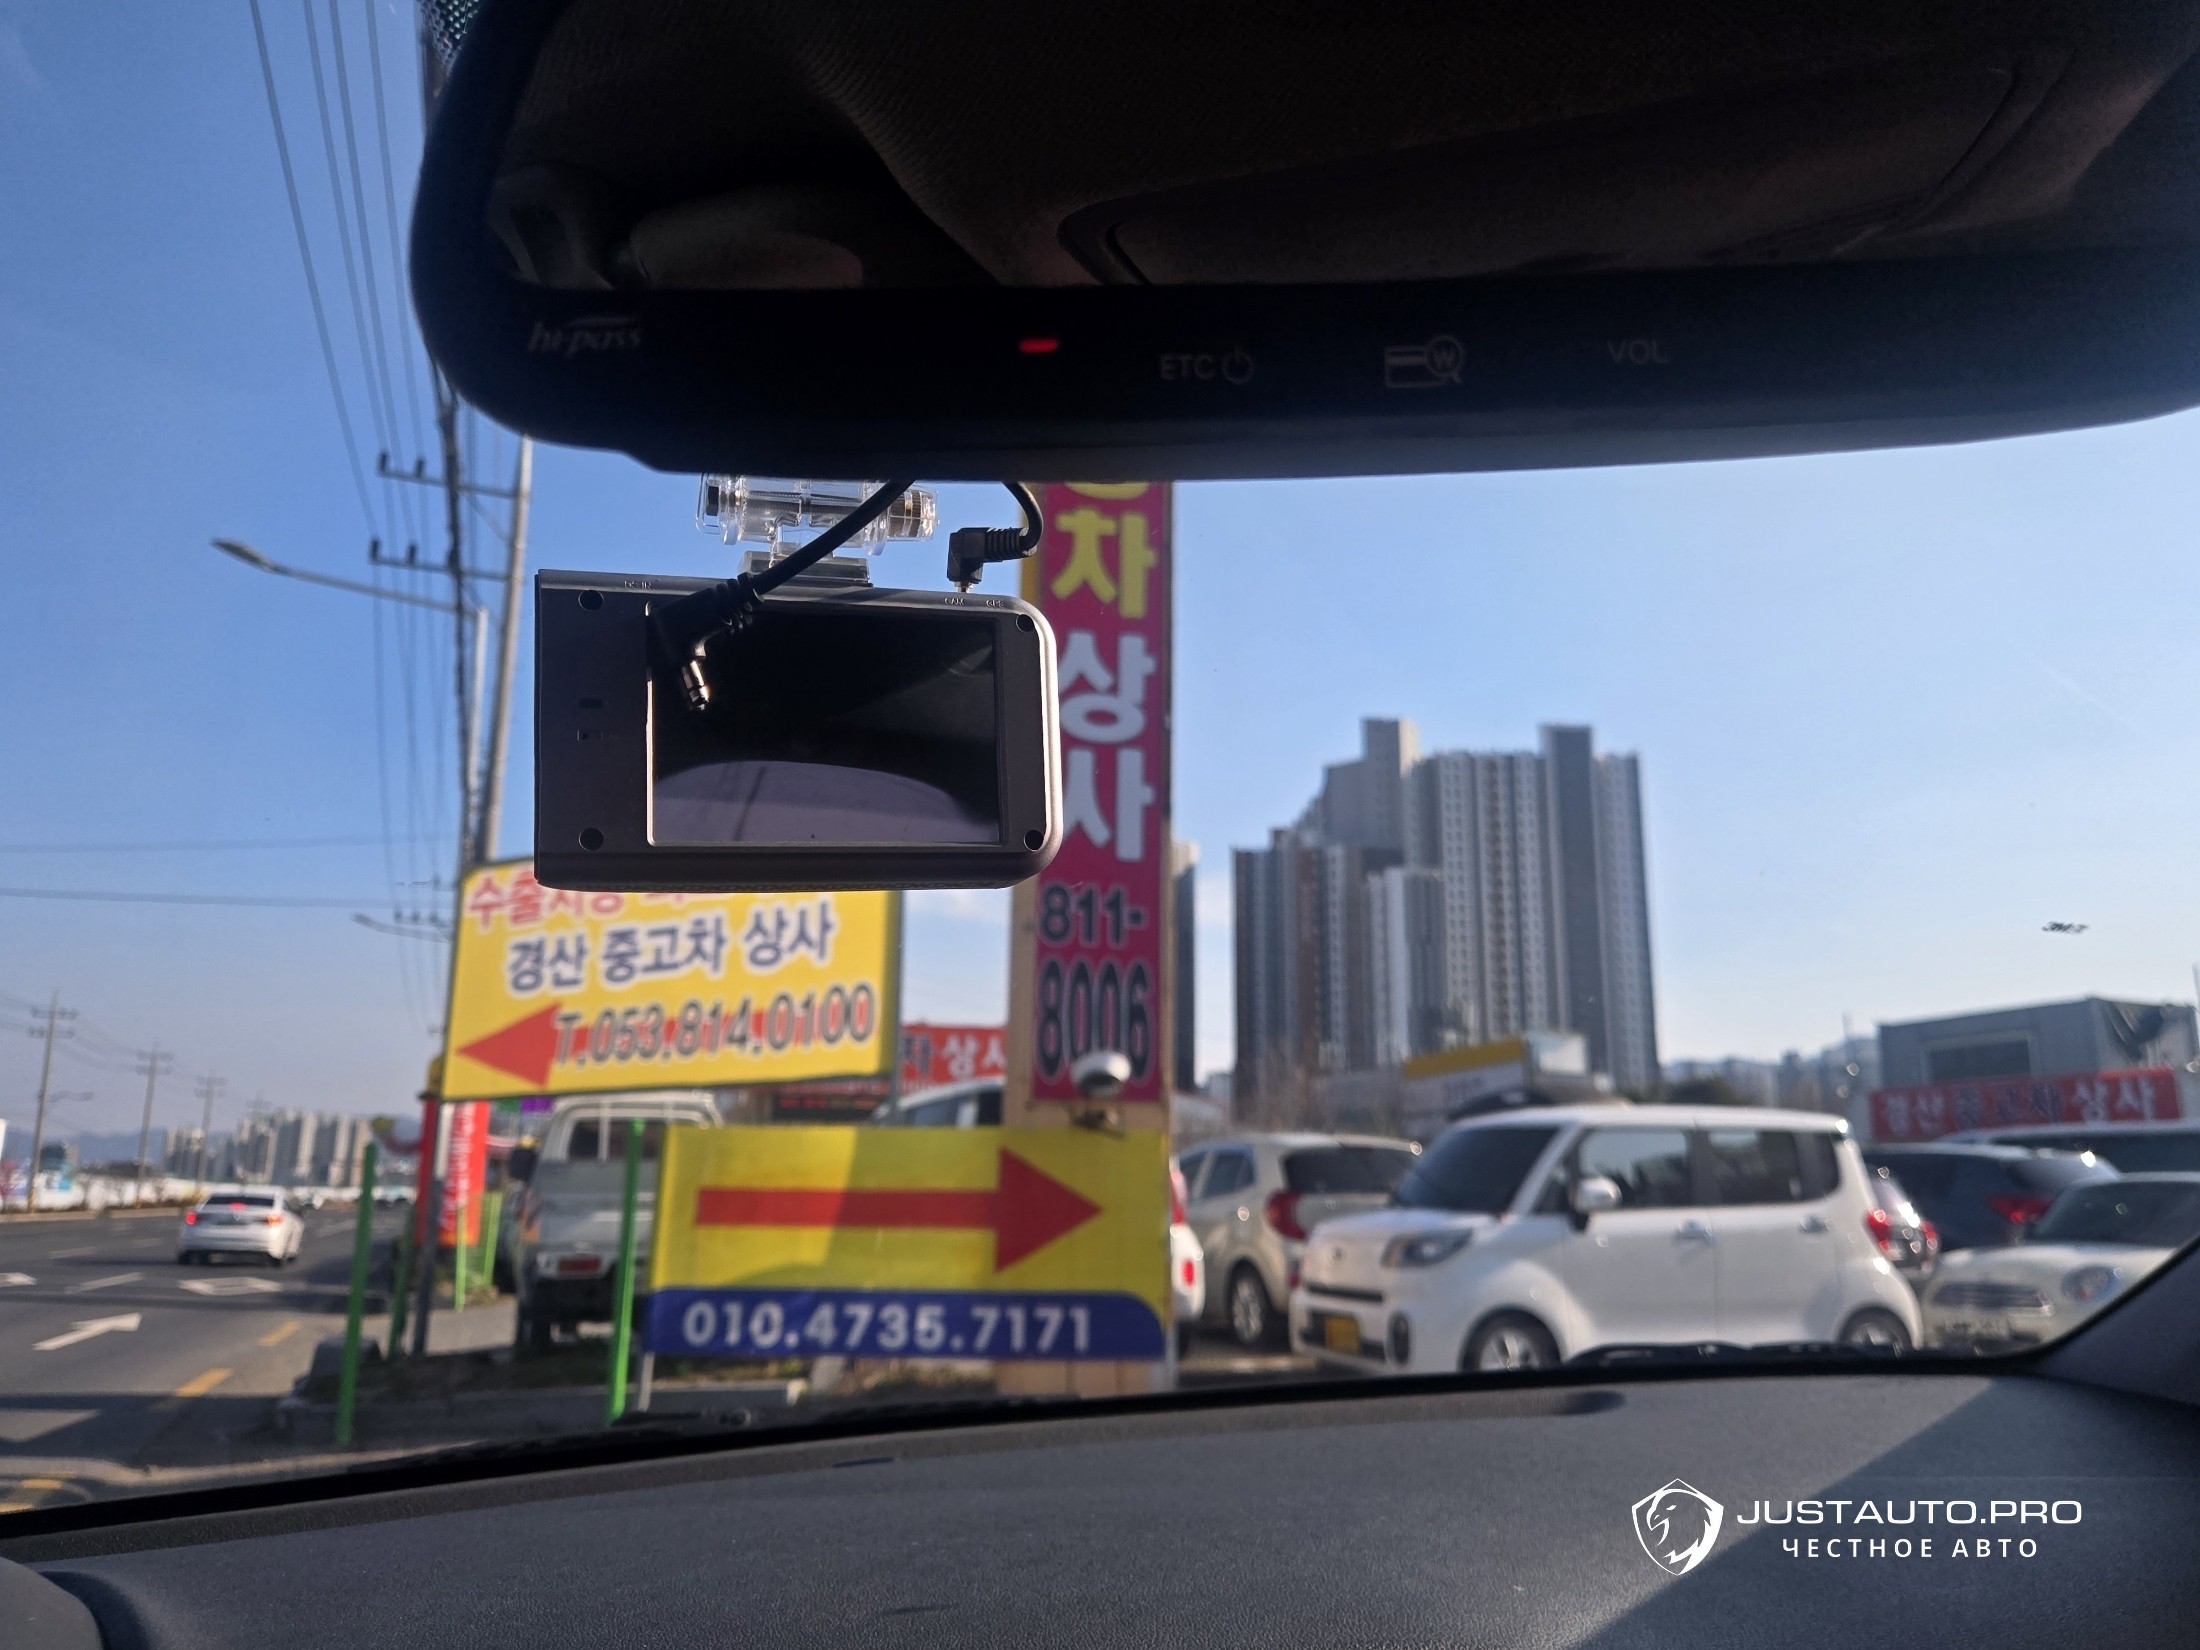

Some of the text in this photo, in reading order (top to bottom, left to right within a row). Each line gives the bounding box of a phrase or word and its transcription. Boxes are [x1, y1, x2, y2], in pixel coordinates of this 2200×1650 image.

[1159, 352, 1217, 381] ETC
[1606, 337, 1669, 365] VOL
[510, 900, 834, 992] 경산 중고차 상사
[1036, 957, 1149, 1080] 8006
[681, 1302, 1092, 1352] 010.4735.7171
